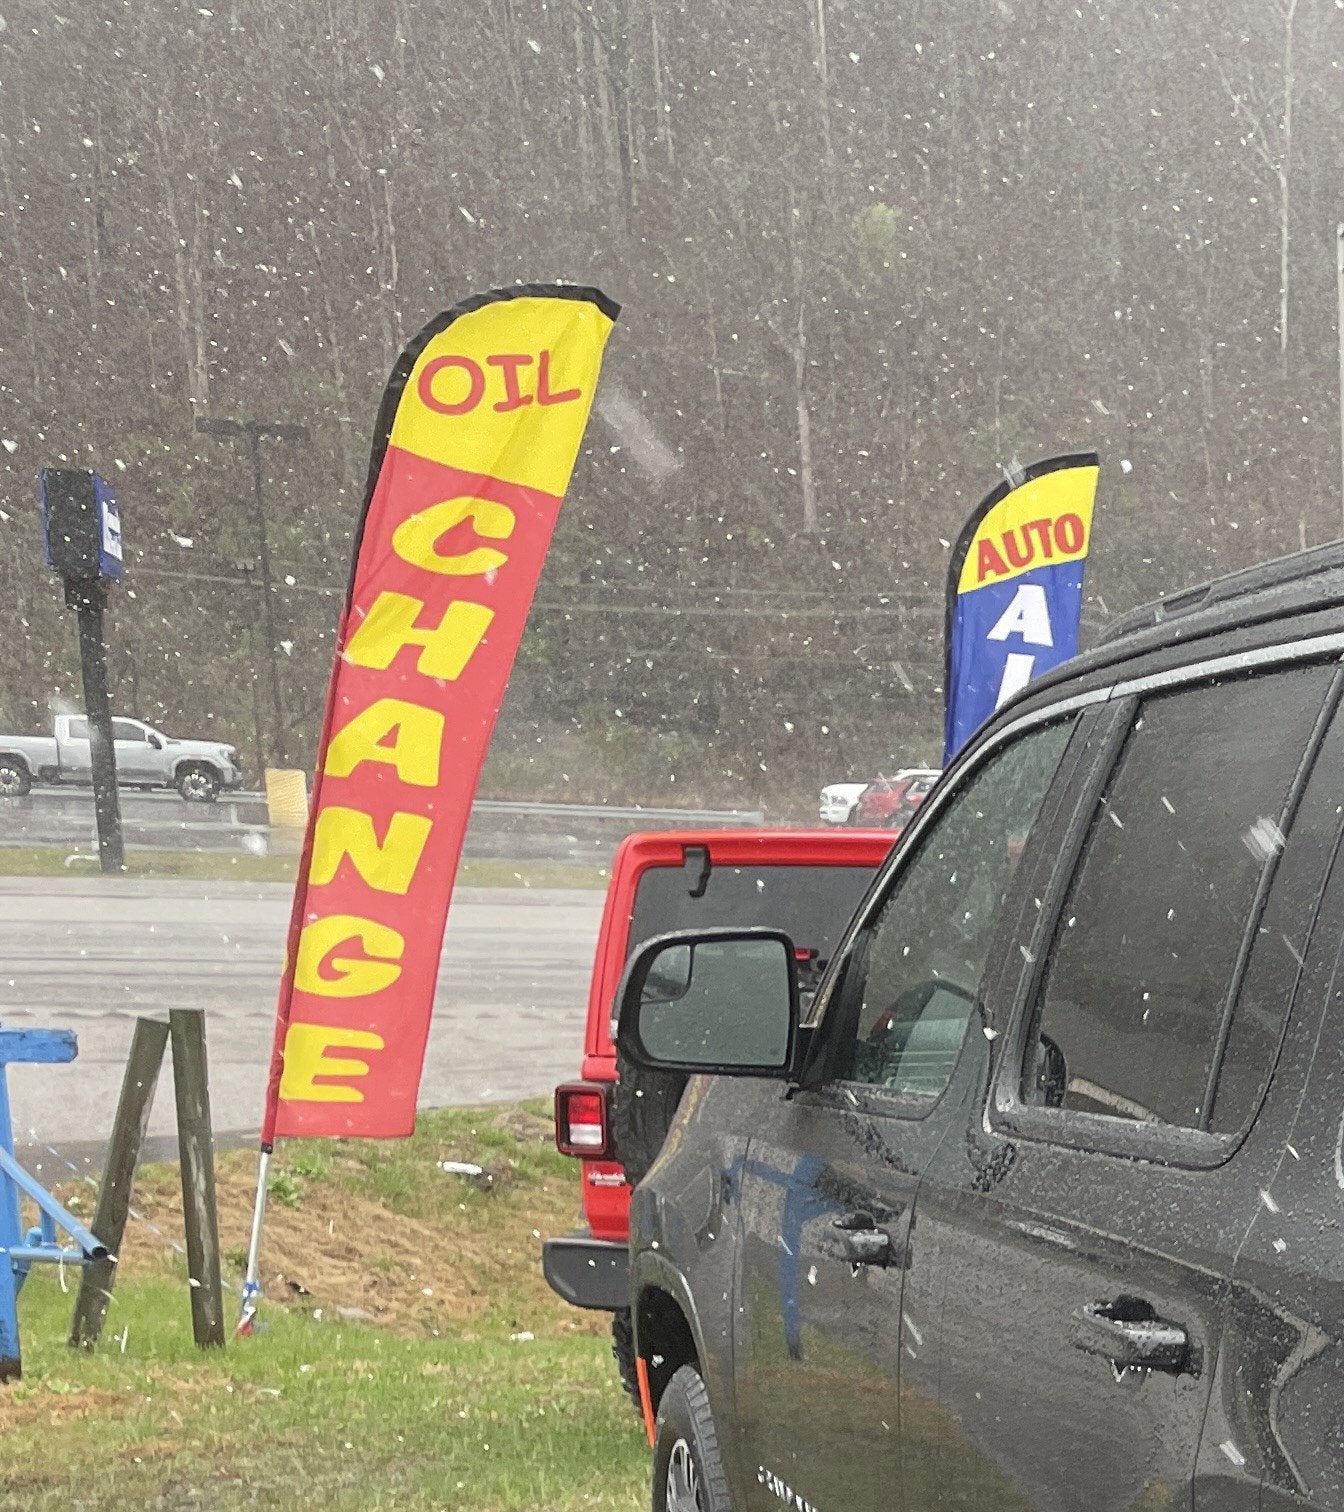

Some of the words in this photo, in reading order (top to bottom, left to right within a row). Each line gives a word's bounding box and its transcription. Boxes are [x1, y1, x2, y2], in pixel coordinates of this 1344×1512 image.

[417, 350, 582, 415] OIL
[976, 513, 1085, 582] AUTO
[279, 496, 516, 1103] CHANGE
